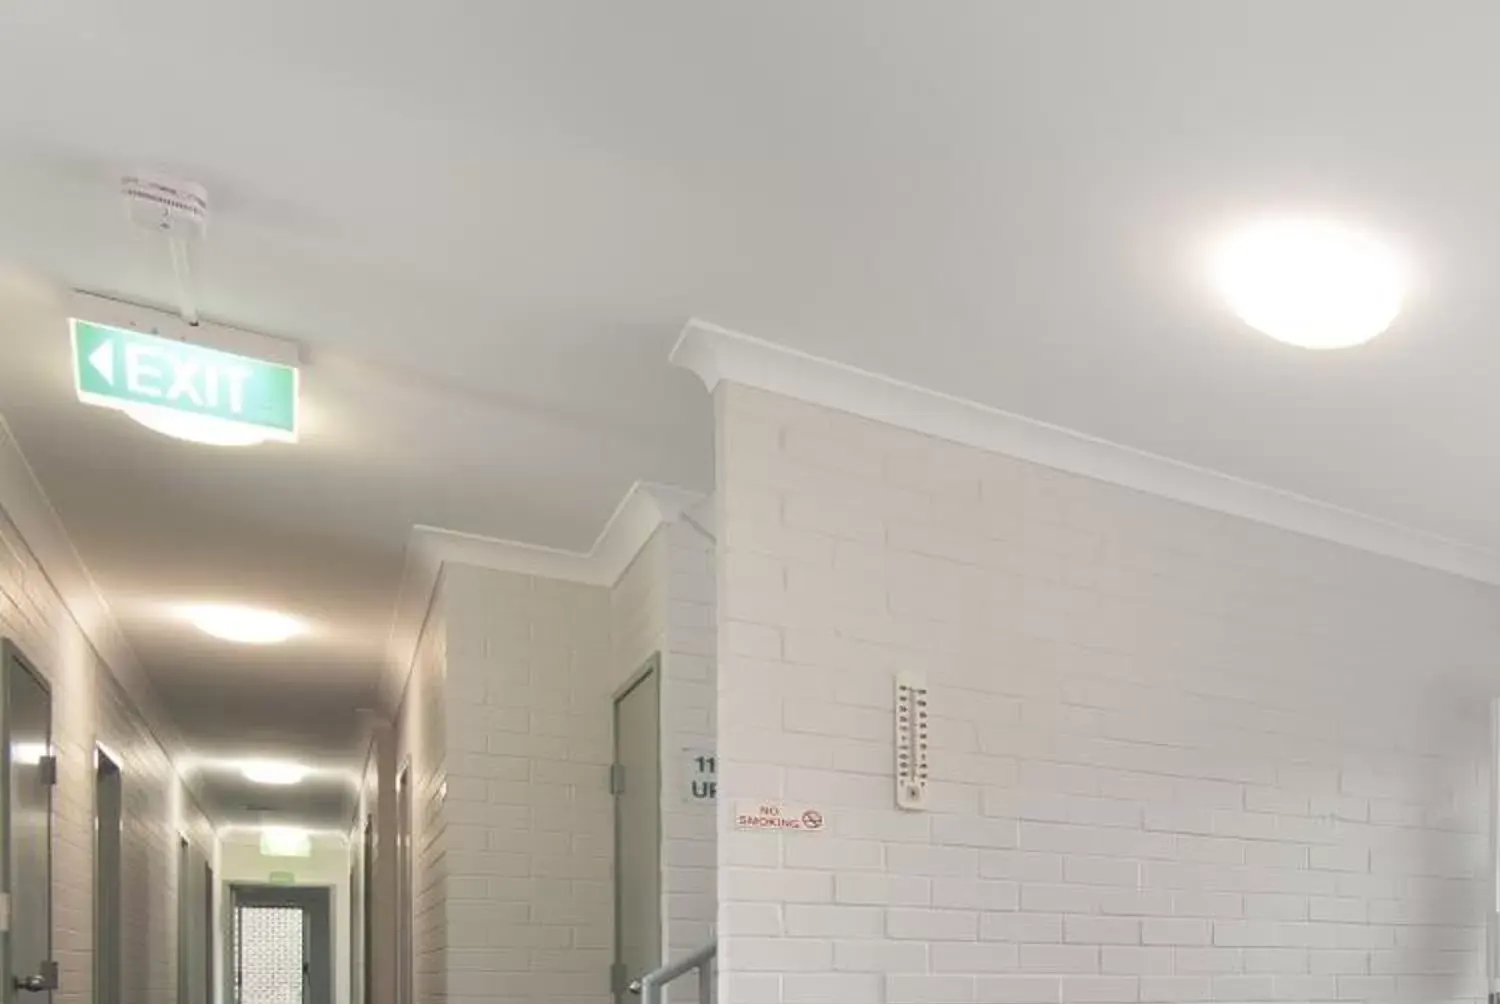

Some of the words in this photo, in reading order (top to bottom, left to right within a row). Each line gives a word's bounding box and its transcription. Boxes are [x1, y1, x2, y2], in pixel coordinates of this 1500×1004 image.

[125, 343, 252, 413] EXIT
[760, 805, 780, 816] NO
[738, 815, 800, 829] SMOKING
